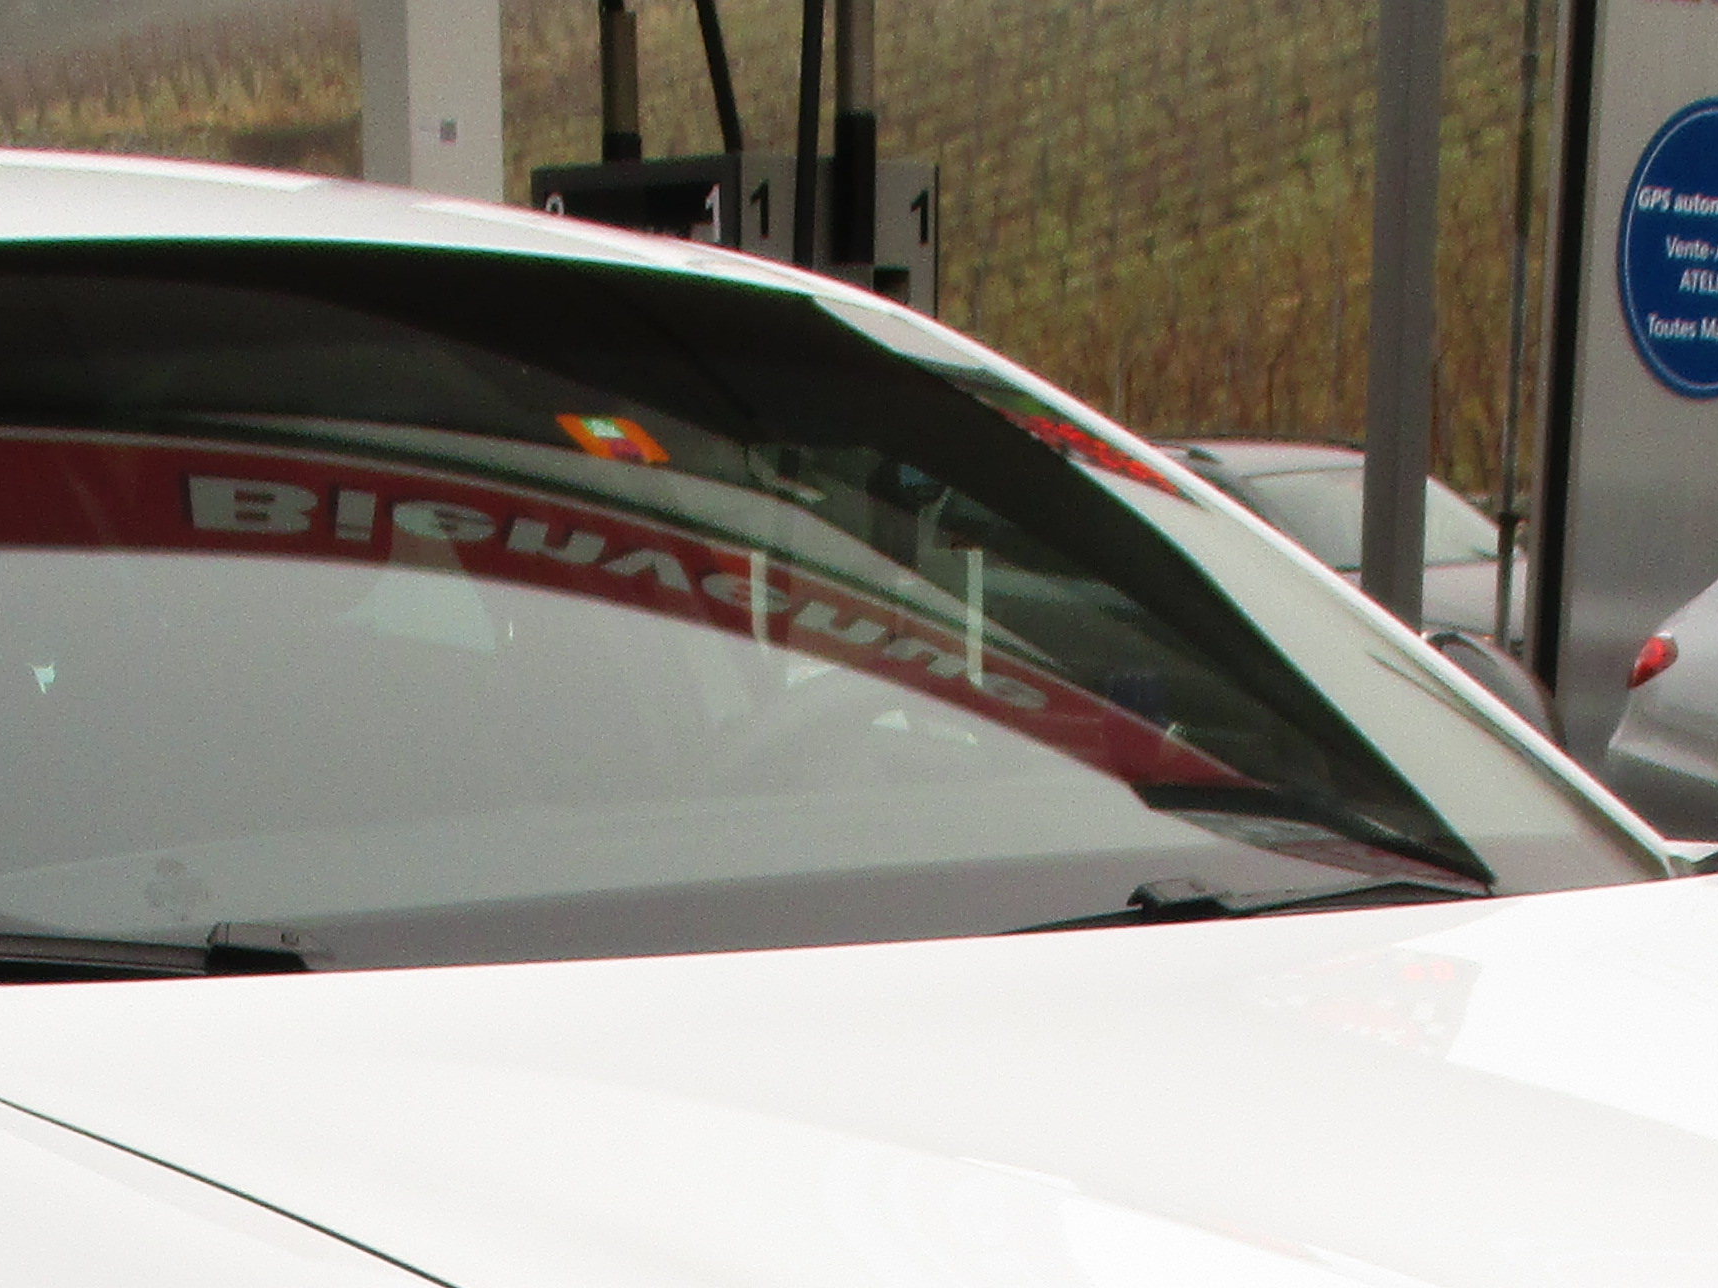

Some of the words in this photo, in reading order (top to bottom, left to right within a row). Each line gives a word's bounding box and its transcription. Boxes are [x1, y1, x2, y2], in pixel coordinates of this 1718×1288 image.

[750, 178, 770, 239] 1
[910, 188, 929, 246] 1
[1638, 186, 1672, 211] GPS
[1647, 313, 1697, 339] Toutes
